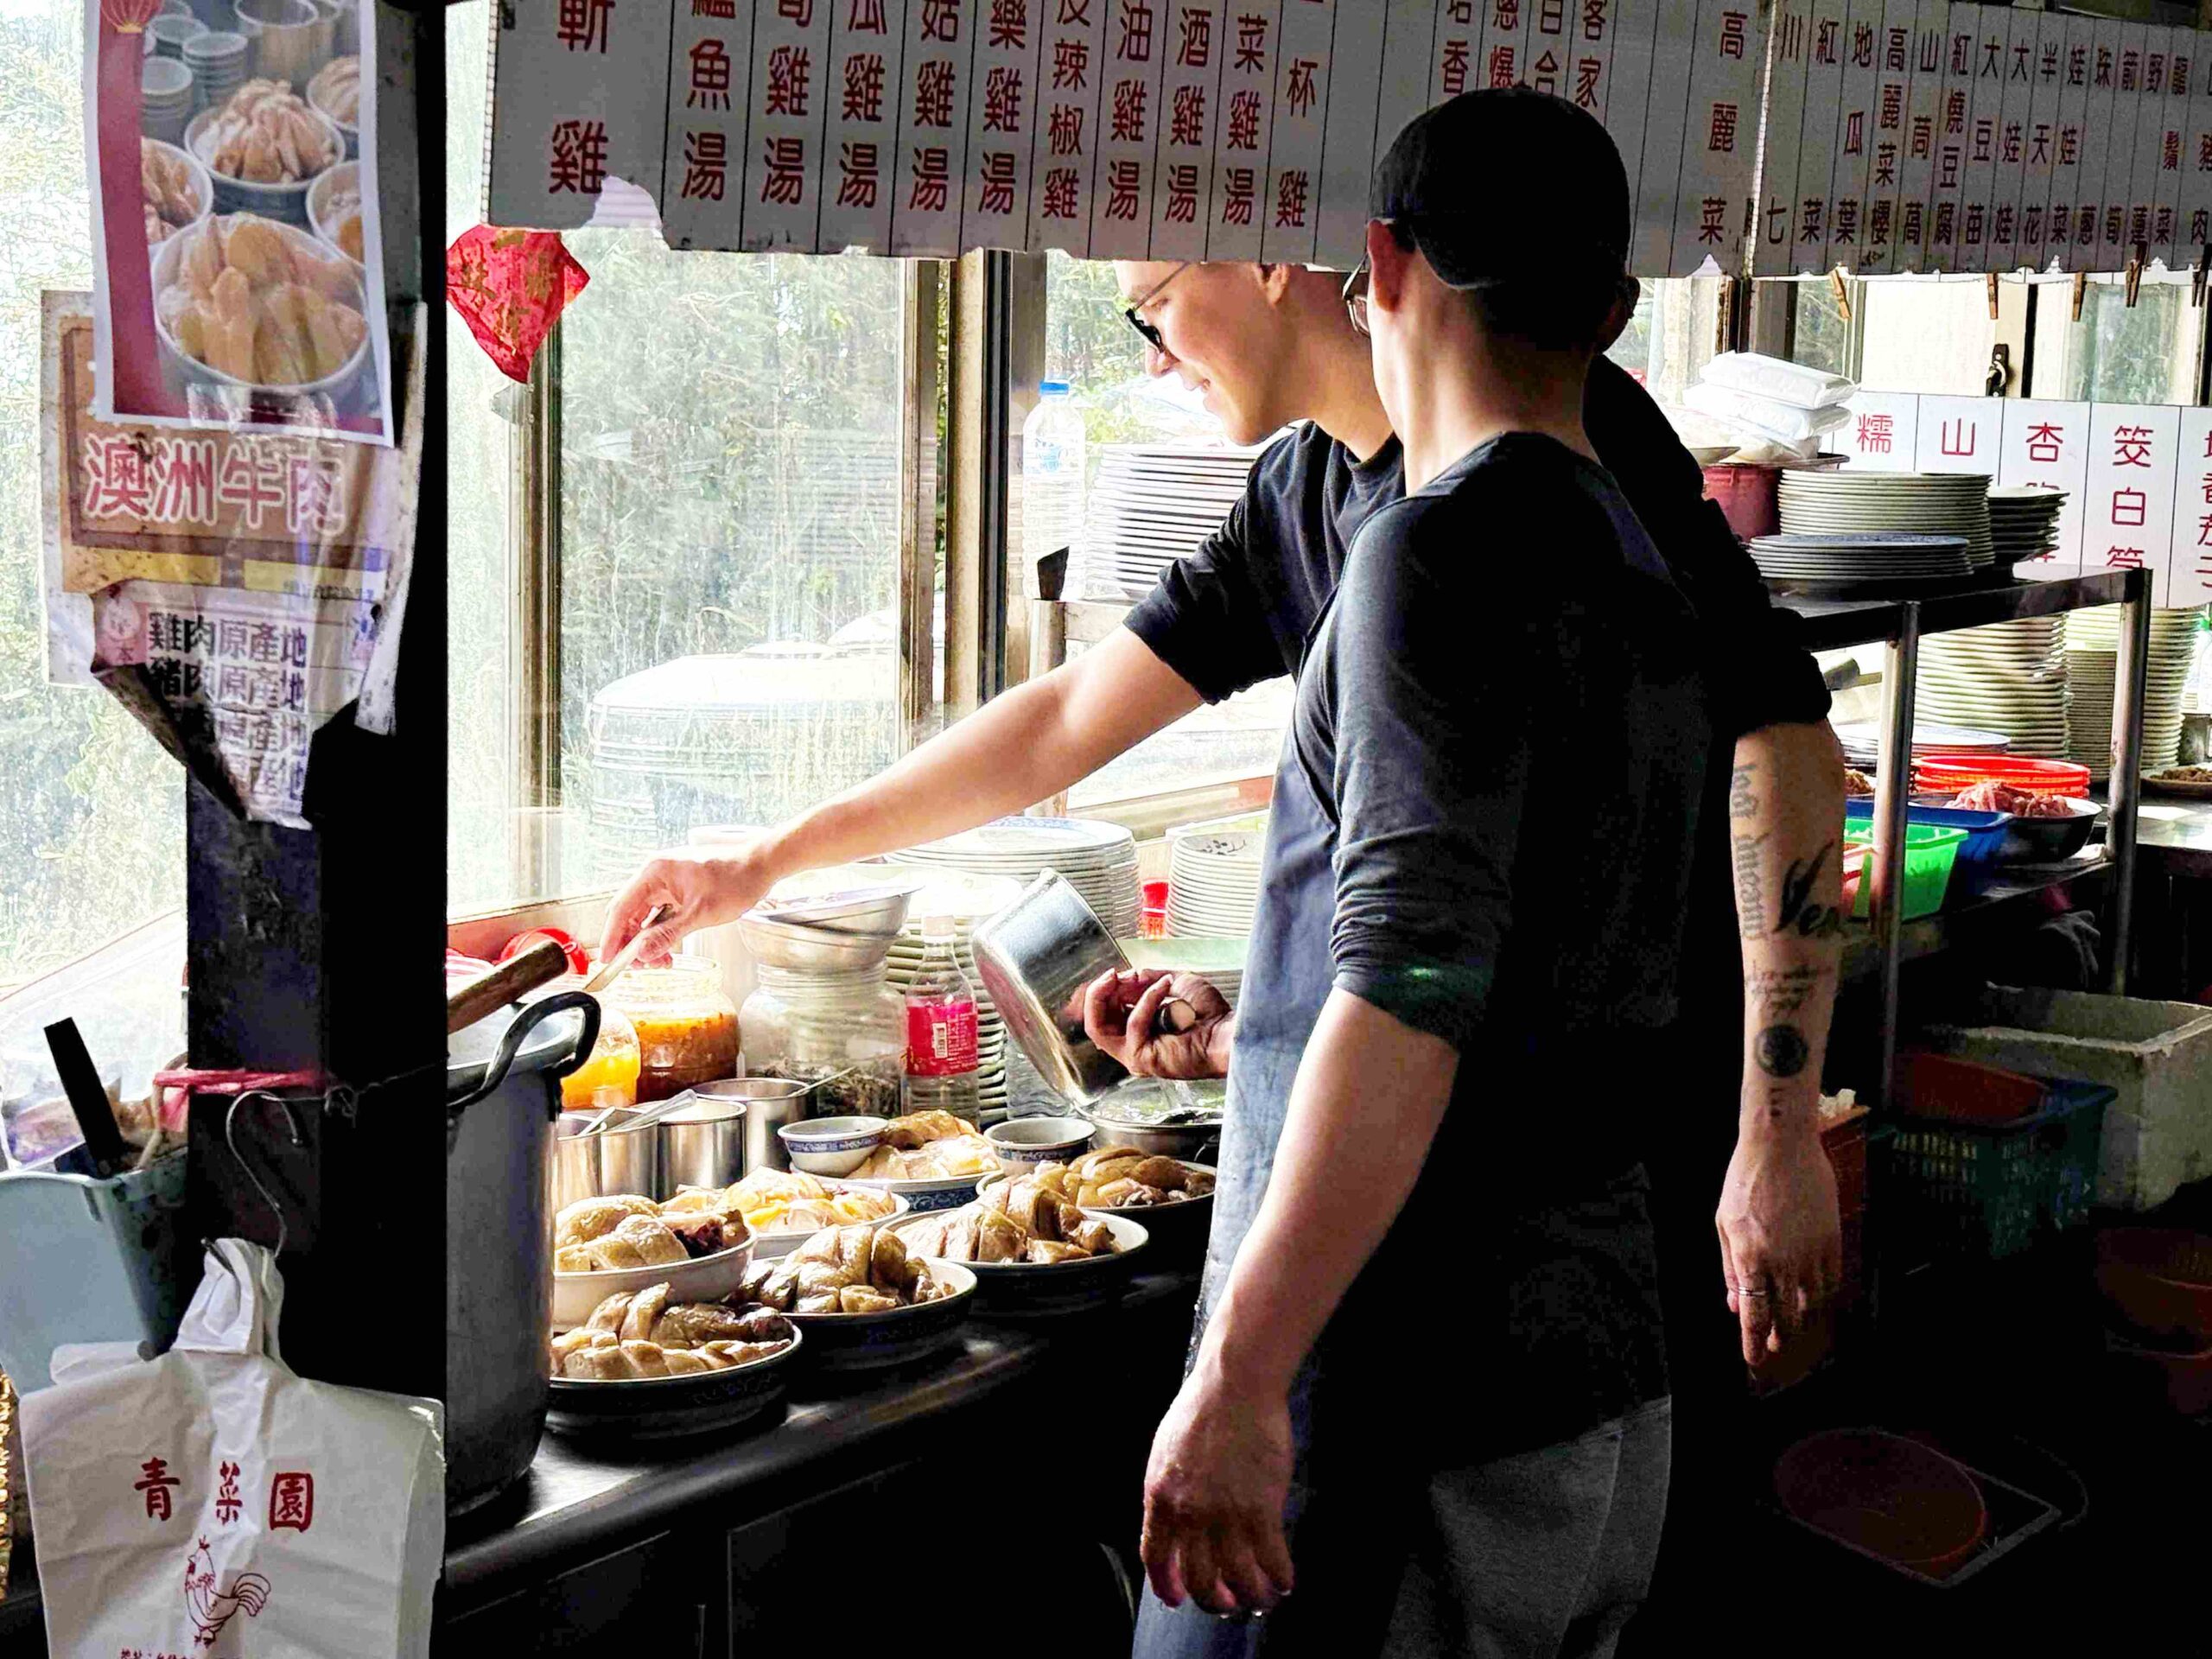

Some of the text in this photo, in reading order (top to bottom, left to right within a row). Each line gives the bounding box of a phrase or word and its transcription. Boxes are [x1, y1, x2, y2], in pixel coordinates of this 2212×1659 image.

[682, 0, 735, 201] 魚湯
[1222, 13, 1268, 226] 菜雞湯
[1275, 0, 1324, 229] 杯雞
[1699, 10, 1748, 245] 高麗菜
[1767, 13, 1802, 245] 川七
[1800, 17, 1839, 243] 紅菜
[1835, 20, 1872, 244] 地瓜葉
[1966, 35, 2000, 245] 大豆苗
